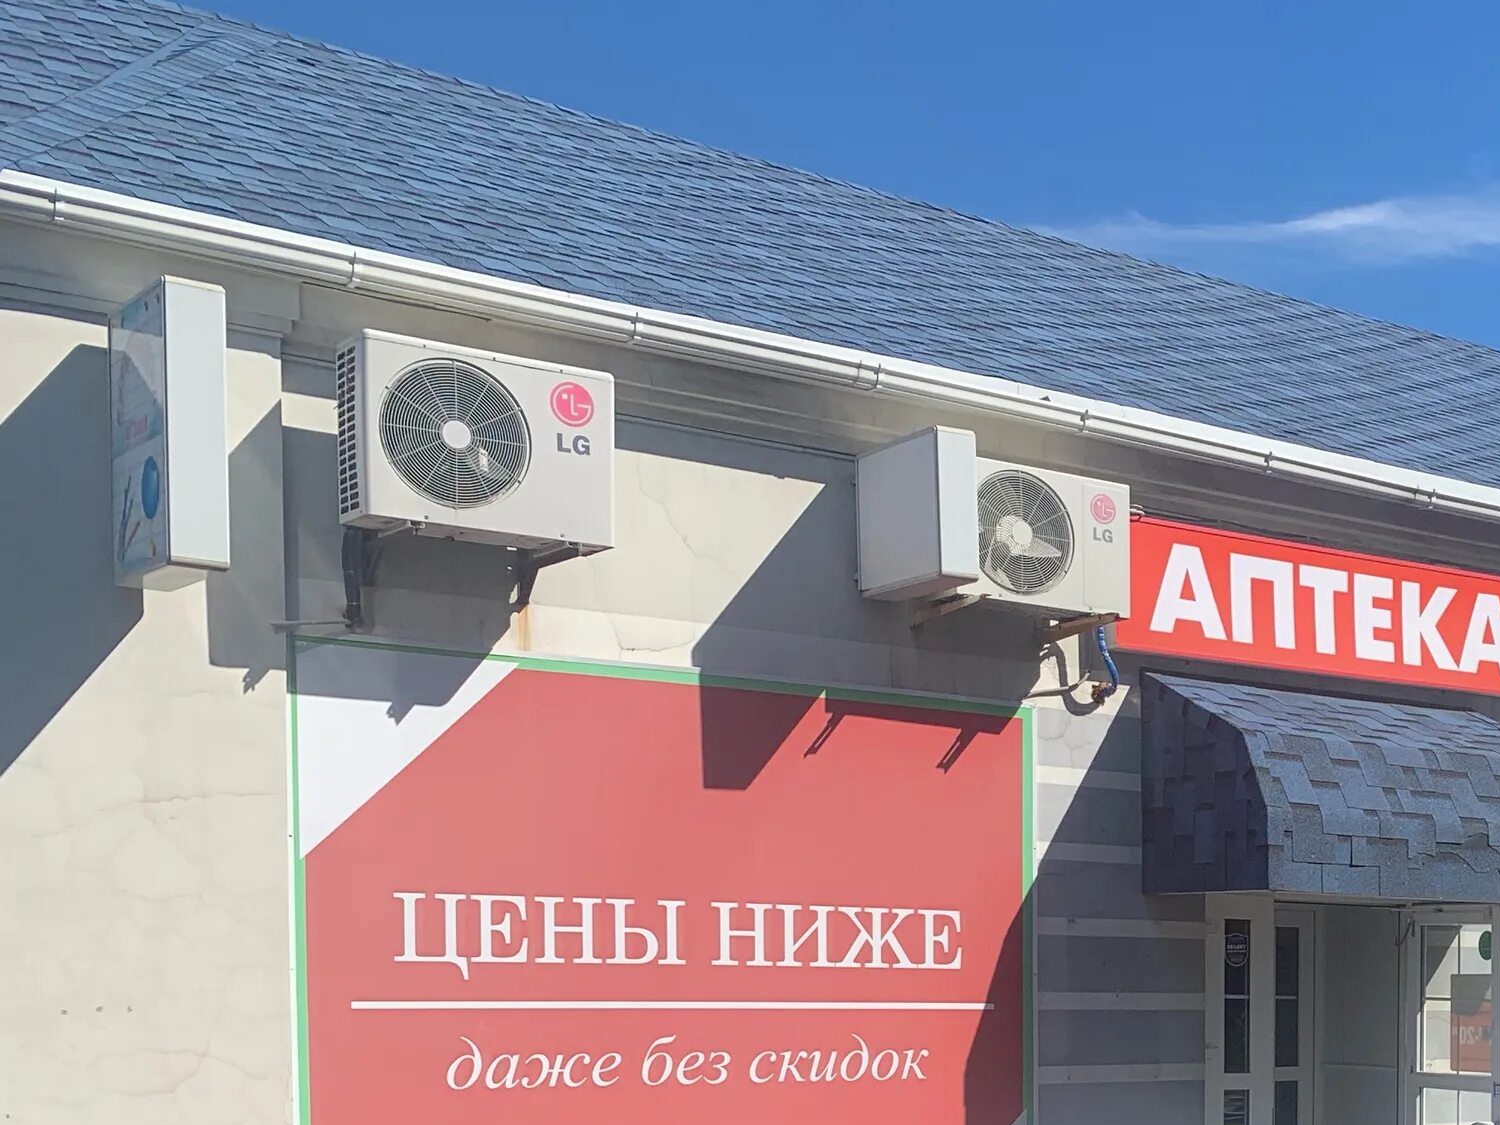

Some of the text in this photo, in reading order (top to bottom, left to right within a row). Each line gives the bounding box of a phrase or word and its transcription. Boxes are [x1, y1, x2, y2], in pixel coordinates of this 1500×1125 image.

[556, 432, 591, 456] LG
[1092, 527, 1113, 543] LG
[393, 891, 963, 981] ЦЕНЫ НИЖЕ
[446, 1033, 929, 1091] даже без скидок
